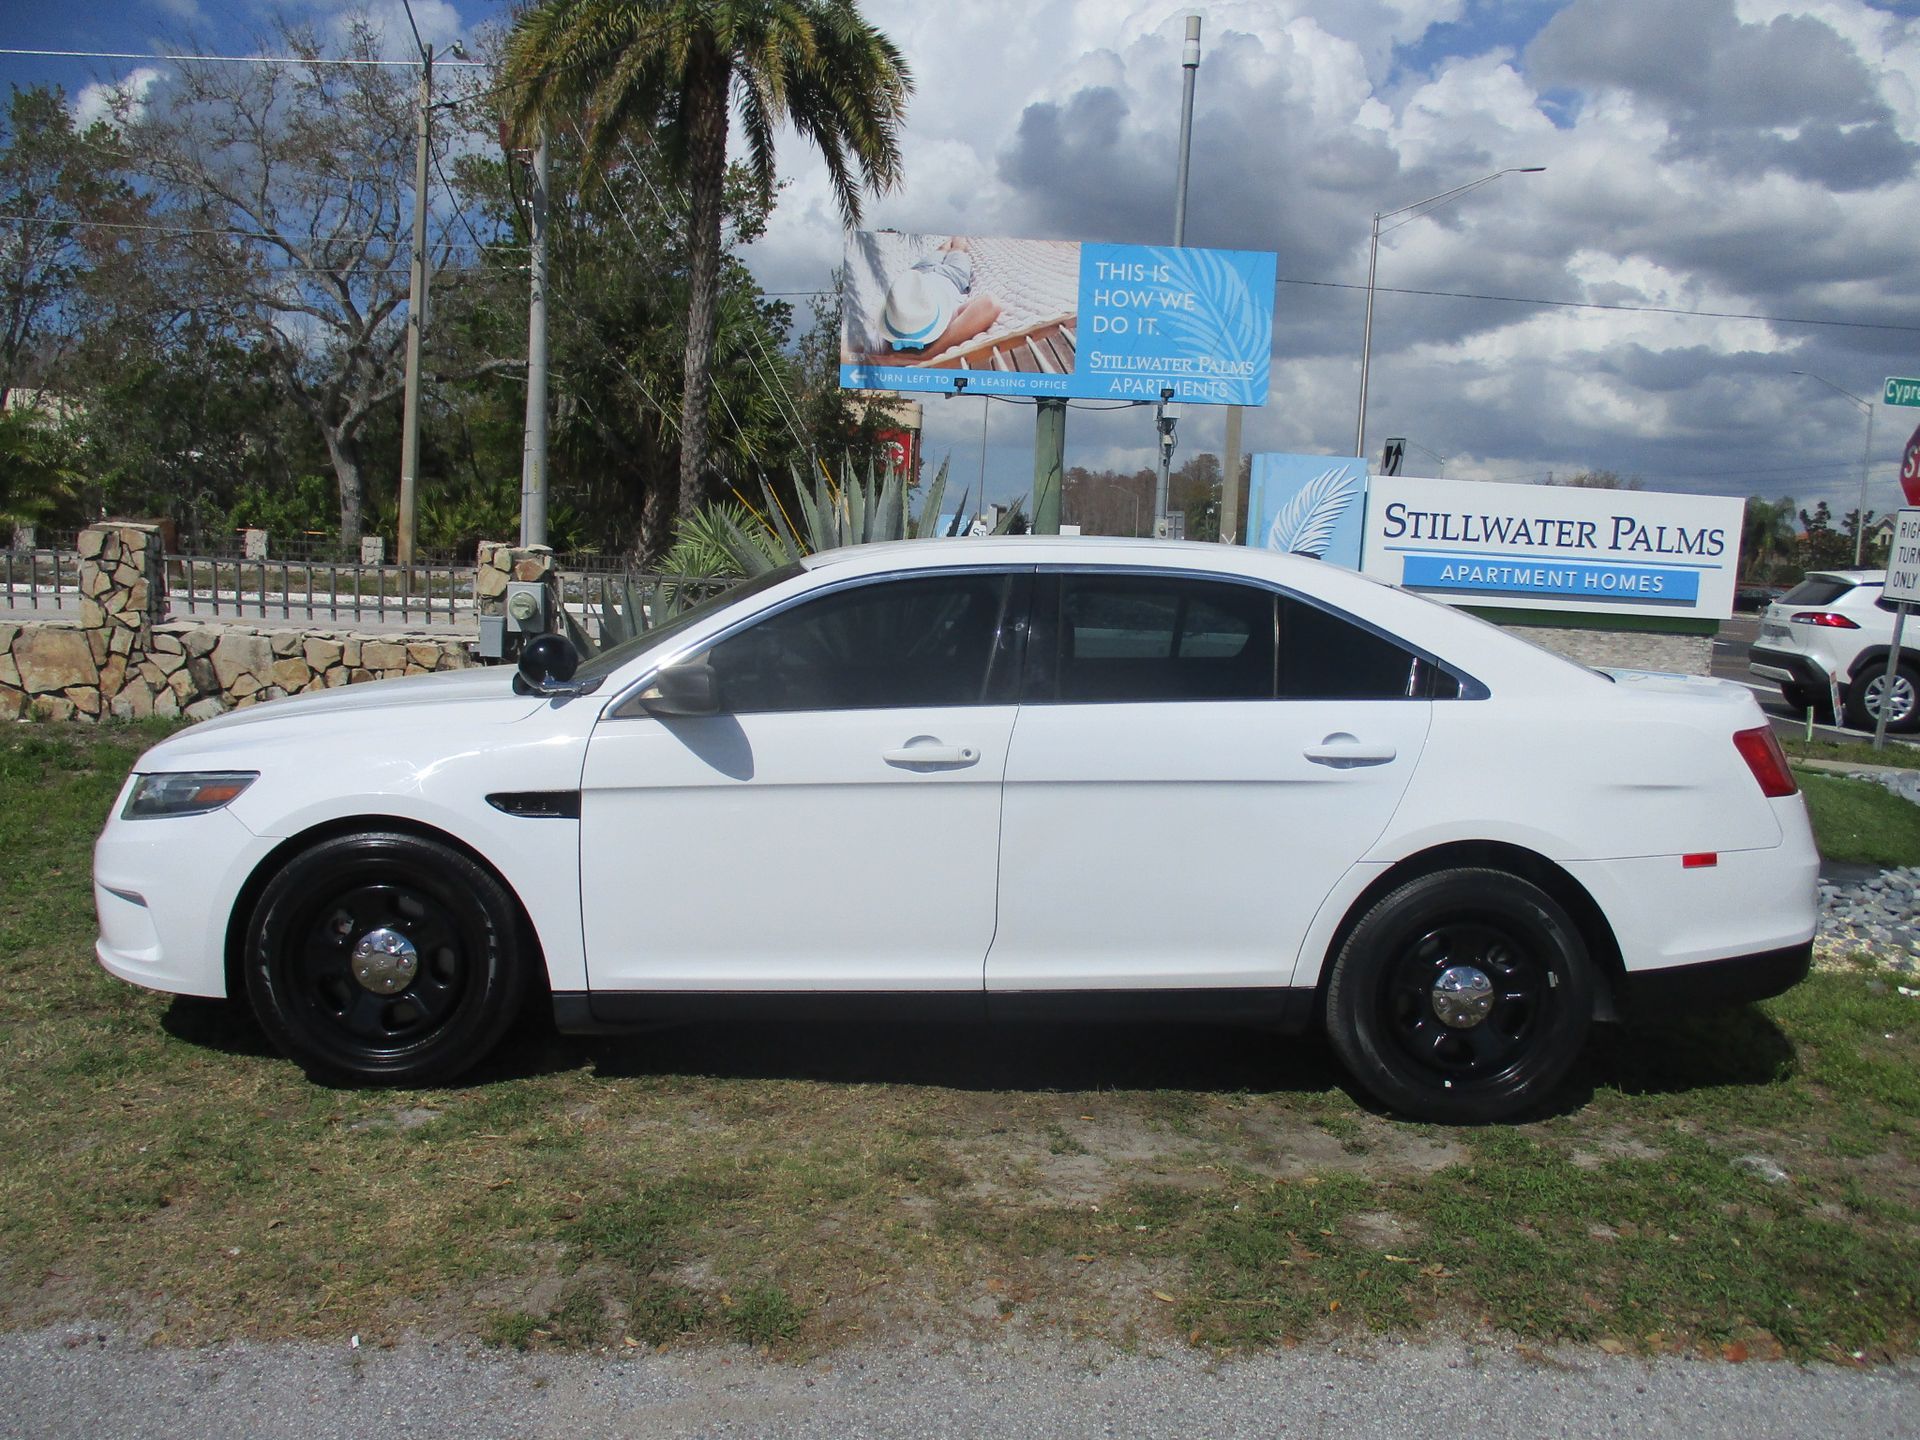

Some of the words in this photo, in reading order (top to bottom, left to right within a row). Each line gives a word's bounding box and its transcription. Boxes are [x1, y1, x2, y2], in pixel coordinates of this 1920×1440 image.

[1095, 262, 1144, 282] THIS
[1153, 264, 1170, 283] IS
[1094, 289, 1153, 309] HOW
[1159, 291, 1197, 311] WE
[1093, 315, 1129, 334] DO
[1137, 317, 1160, 336] IT.
[1089, 351, 1193, 372] STILLWATER
[1199, 355, 1255, 375] PALMS
[906, 375, 931, 384] LEFT
[934, 376, 949, 385] TO
[981, 377, 1026, 388] LEASING
[1029, 379, 1068, 390] OFFICE
[1109, 377, 1230, 397] APARTMENTS
[1383, 502, 1597, 549] STILLWATER
[1607, 515, 1725, 556] PALMS
[1439, 564, 1578, 588] APARTMENT
[1584, 572, 1664, 593] HOMES
[1893, 570, 1919, 589] ONLY
